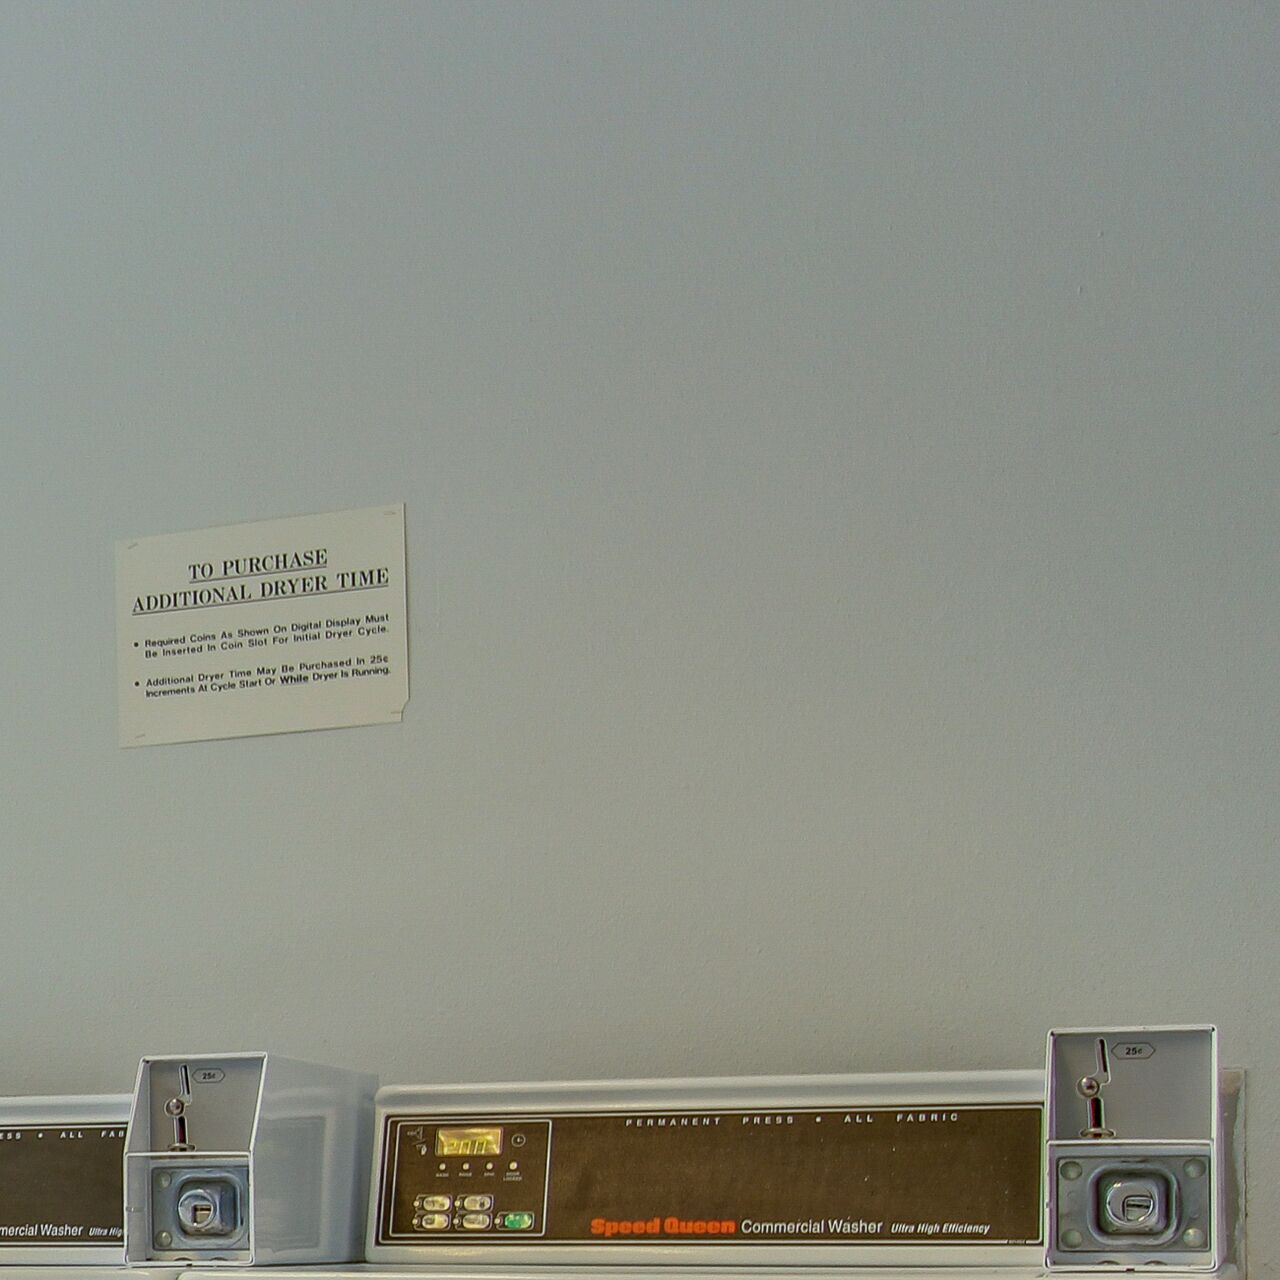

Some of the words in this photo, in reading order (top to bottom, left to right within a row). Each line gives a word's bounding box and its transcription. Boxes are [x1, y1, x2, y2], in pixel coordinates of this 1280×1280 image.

[188, 562, 213, 581] TO
[223, 549, 327, 577] PURCHASE
[132, 584, 252, 613] ADDITIONAL
[261, 575, 327, 598] DRYER
[337, 568, 389, 589] TIME
[145, 635, 186, 649] Required
[190, 632, 216, 643] Coins
[221, 630, 232, 639] As
[238, 626, 269, 638] Shown
[273, 624, 287, 634] On
[291, 621, 321, 633] Digital
[326, 616, 361, 628] Display
[365, 613, 389, 624] Must
[145, 649, 157, 658] Be
[163, 644, 202, 656] Inserted
[208, 643, 216, 652] In
[221, 640, 243, 650] Coin
[248, 637, 267, 647] Slot
[273, 635, 288, 645] For
[294, 632, 320, 643] Initial
[326, 629, 352, 640] Dryer
[358, 625, 388, 637] Cycle.
[146, 674, 194, 687] Additional
[198, 671, 224, 683] Dryer
[230, 669, 252, 679] Time
[257, 666, 276, 677] May
[282, 664, 294, 674] Be
[300, 659, 352, 672] Purchased
[357, 658, 365, 666] In
[146, 685, 195, 698] Increments
[198, 684, 208, 692] At
[211, 681, 236, 692] Cycle
[240, 678, 261, 688] Start
[265, 677, 276, 685] Or
[280, 673, 309, 684] While
[312, 670, 337, 682] Dryer
[341, 669, 349, 678] Is
[352, 665, 391, 677] Running.
[100, 1130, 125, 1138] FAB
[625, 1117, 721, 1127] PERMANENT
[742, 1116, 794, 1125] PRESS
[844, 1114, 874, 1123] ALL
[897, 1113, 958, 1122] FABRIC
[40, 1223, 84, 1237] Washer
[89, 1227, 109, 1236] Ultra
[110, 1227, 123, 1238] Hig
[591, 1216, 660, 1236] Speed
[664, 1216, 736, 1234] Queen
[741, 1219, 824, 1234] Commercial
[828, 1219, 883, 1234] Washer
[891, 1223, 915, 1234] Ultra
[917, 1223, 940, 1235] High
[942, 1223, 990, 1235] Efficiency
